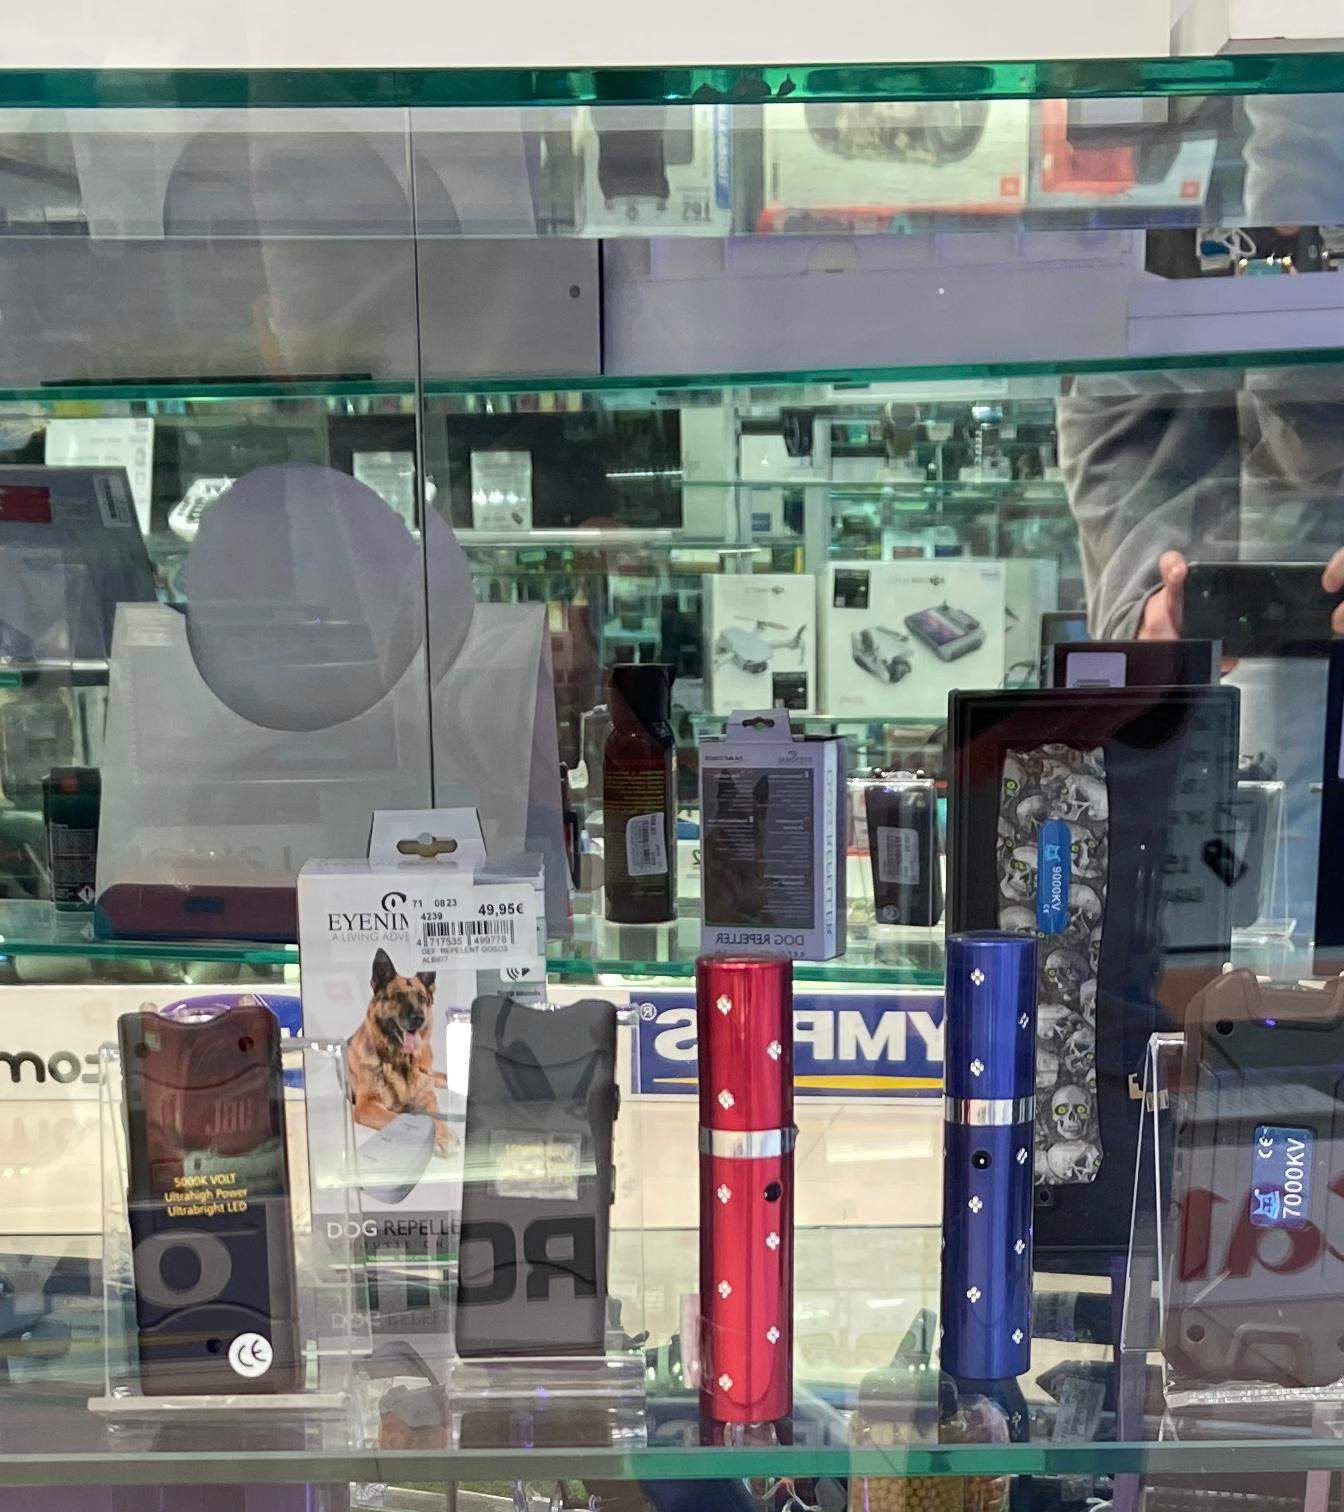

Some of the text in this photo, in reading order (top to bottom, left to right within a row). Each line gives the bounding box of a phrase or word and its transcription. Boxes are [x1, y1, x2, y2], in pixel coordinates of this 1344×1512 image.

[478, 903, 524, 917] 49,95€
[174, 1173, 236, 1188] 5000K VOLT
[1283, 1137, 1306, 1219] 7000KV
[165, 1187, 248, 1204] Ultrahigh Power
[167, 1200, 248, 1216] Ultrabright LED
[327, 1218, 460, 1239] DOG REPELLE
